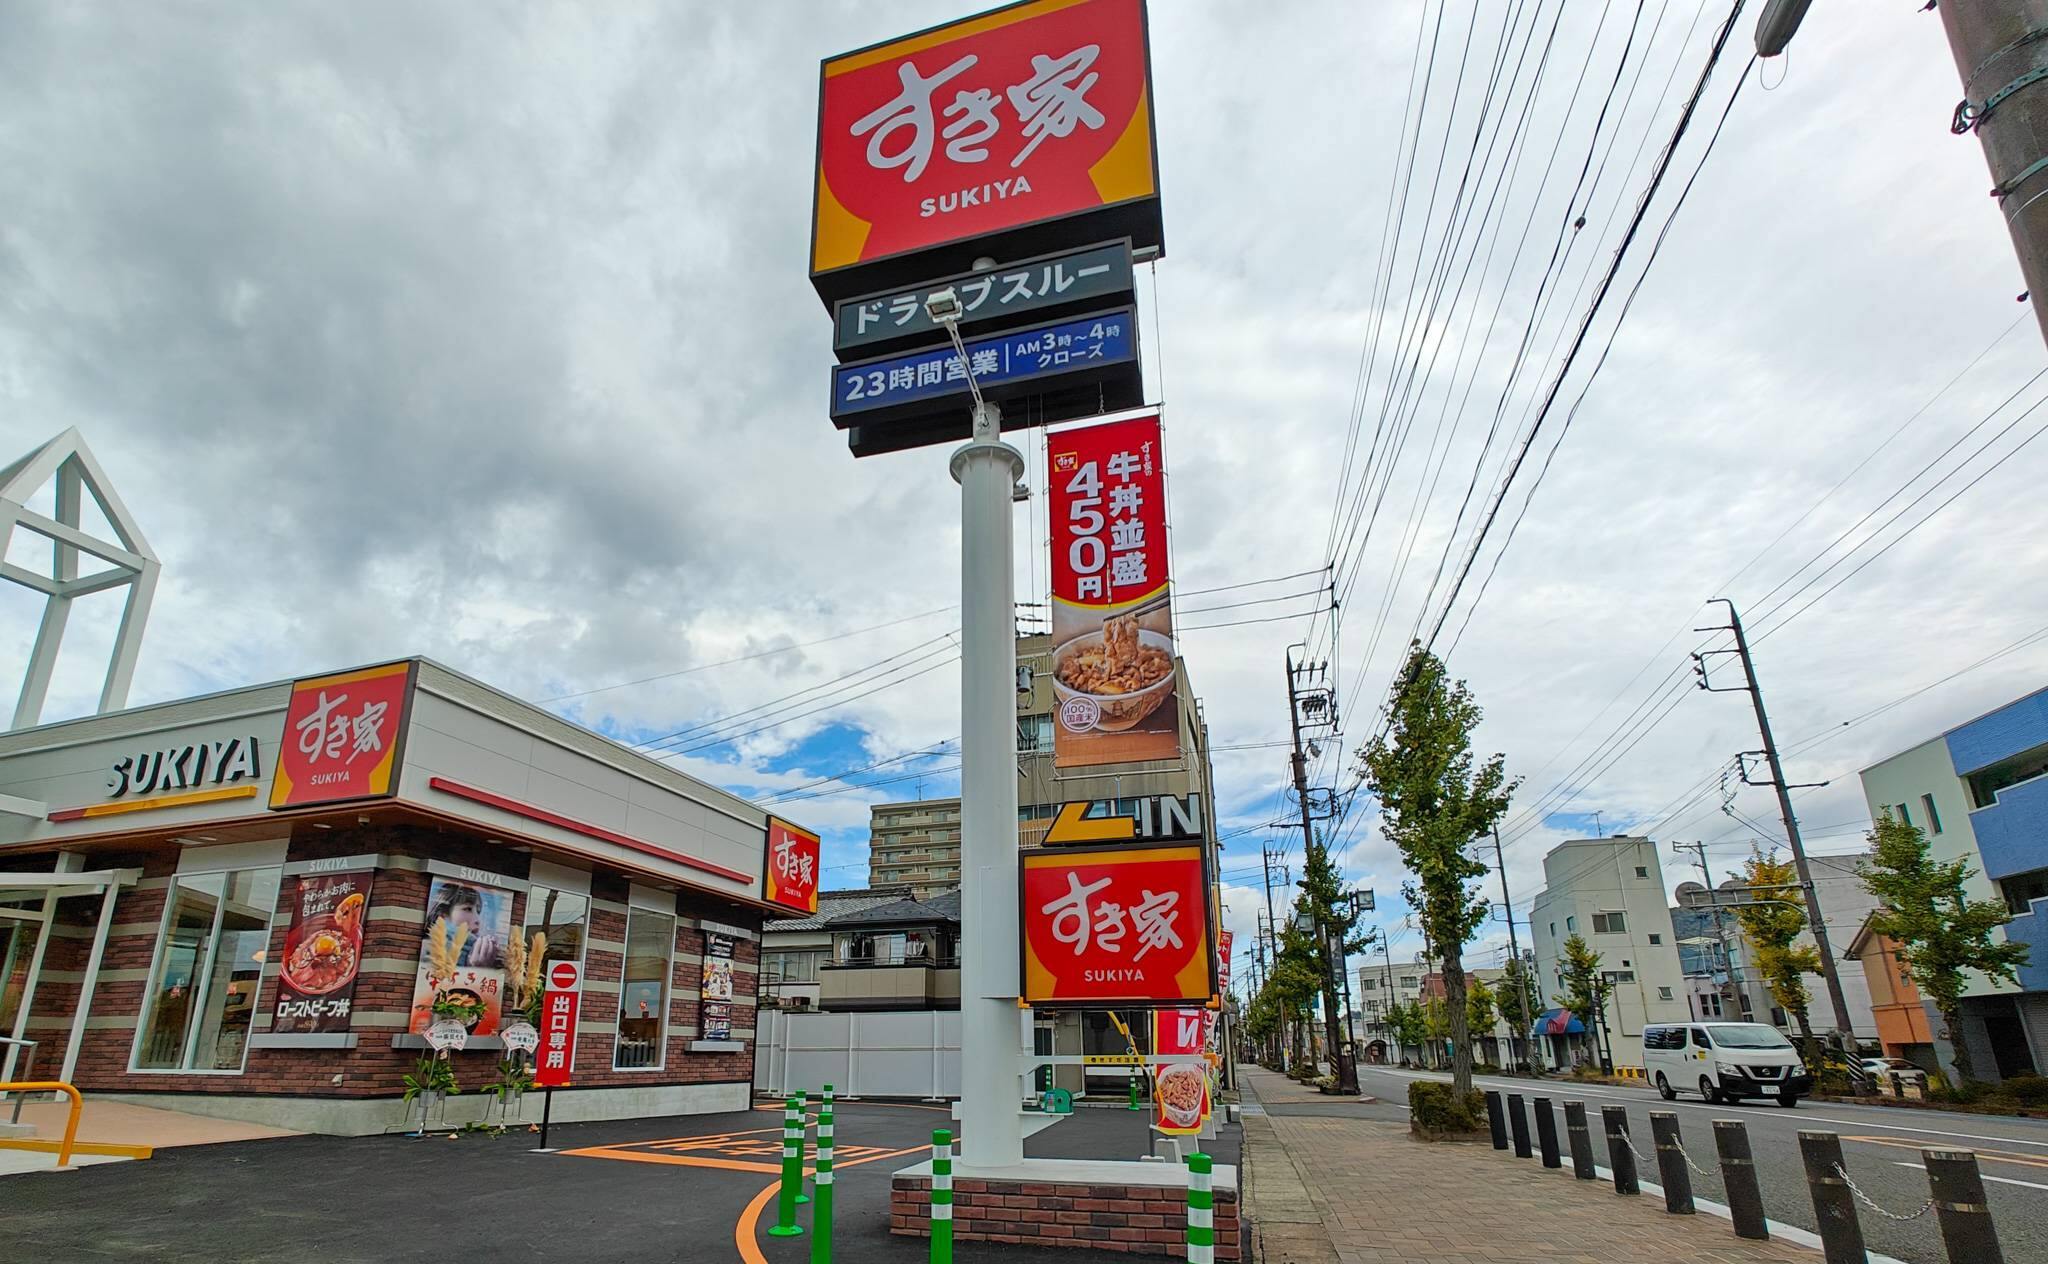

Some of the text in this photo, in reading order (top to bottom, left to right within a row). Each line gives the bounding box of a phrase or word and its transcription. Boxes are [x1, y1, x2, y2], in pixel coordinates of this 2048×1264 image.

[850, 44, 1105, 183] すき家
[920, 176, 1032, 217] SUKIYA
[856, 264, 1109, 335] ドラブスルー
[846, 348, 998, 401] 23時間営業
[1037, 343, 1103, 369] クローズ
[1066, 461, 1106, 600] 450円
[1107, 451, 1147, 587] 牛丼並盛
[296, 691, 389, 765] すき家
[1066, 712, 1093, 723] 国産米
[106, 735, 260, 798] SUKIYA
[310, 772, 350, 785] SUKIYA
[1139, 794, 1201, 837] IN
[309, 857, 349, 872] SUKIYA
[460, 866, 501, 886] SUKIYA
[774, 831, 814, 888] すき家
[303, 881, 356, 904] やわらかお肉に
[1042, 871, 1183, 962] すき家
[1084, 968, 1145, 982] SUKIYA
[277, 998, 351, 1018] ローストビーフ丼
[546, 995, 570, 1069] 出口専用
